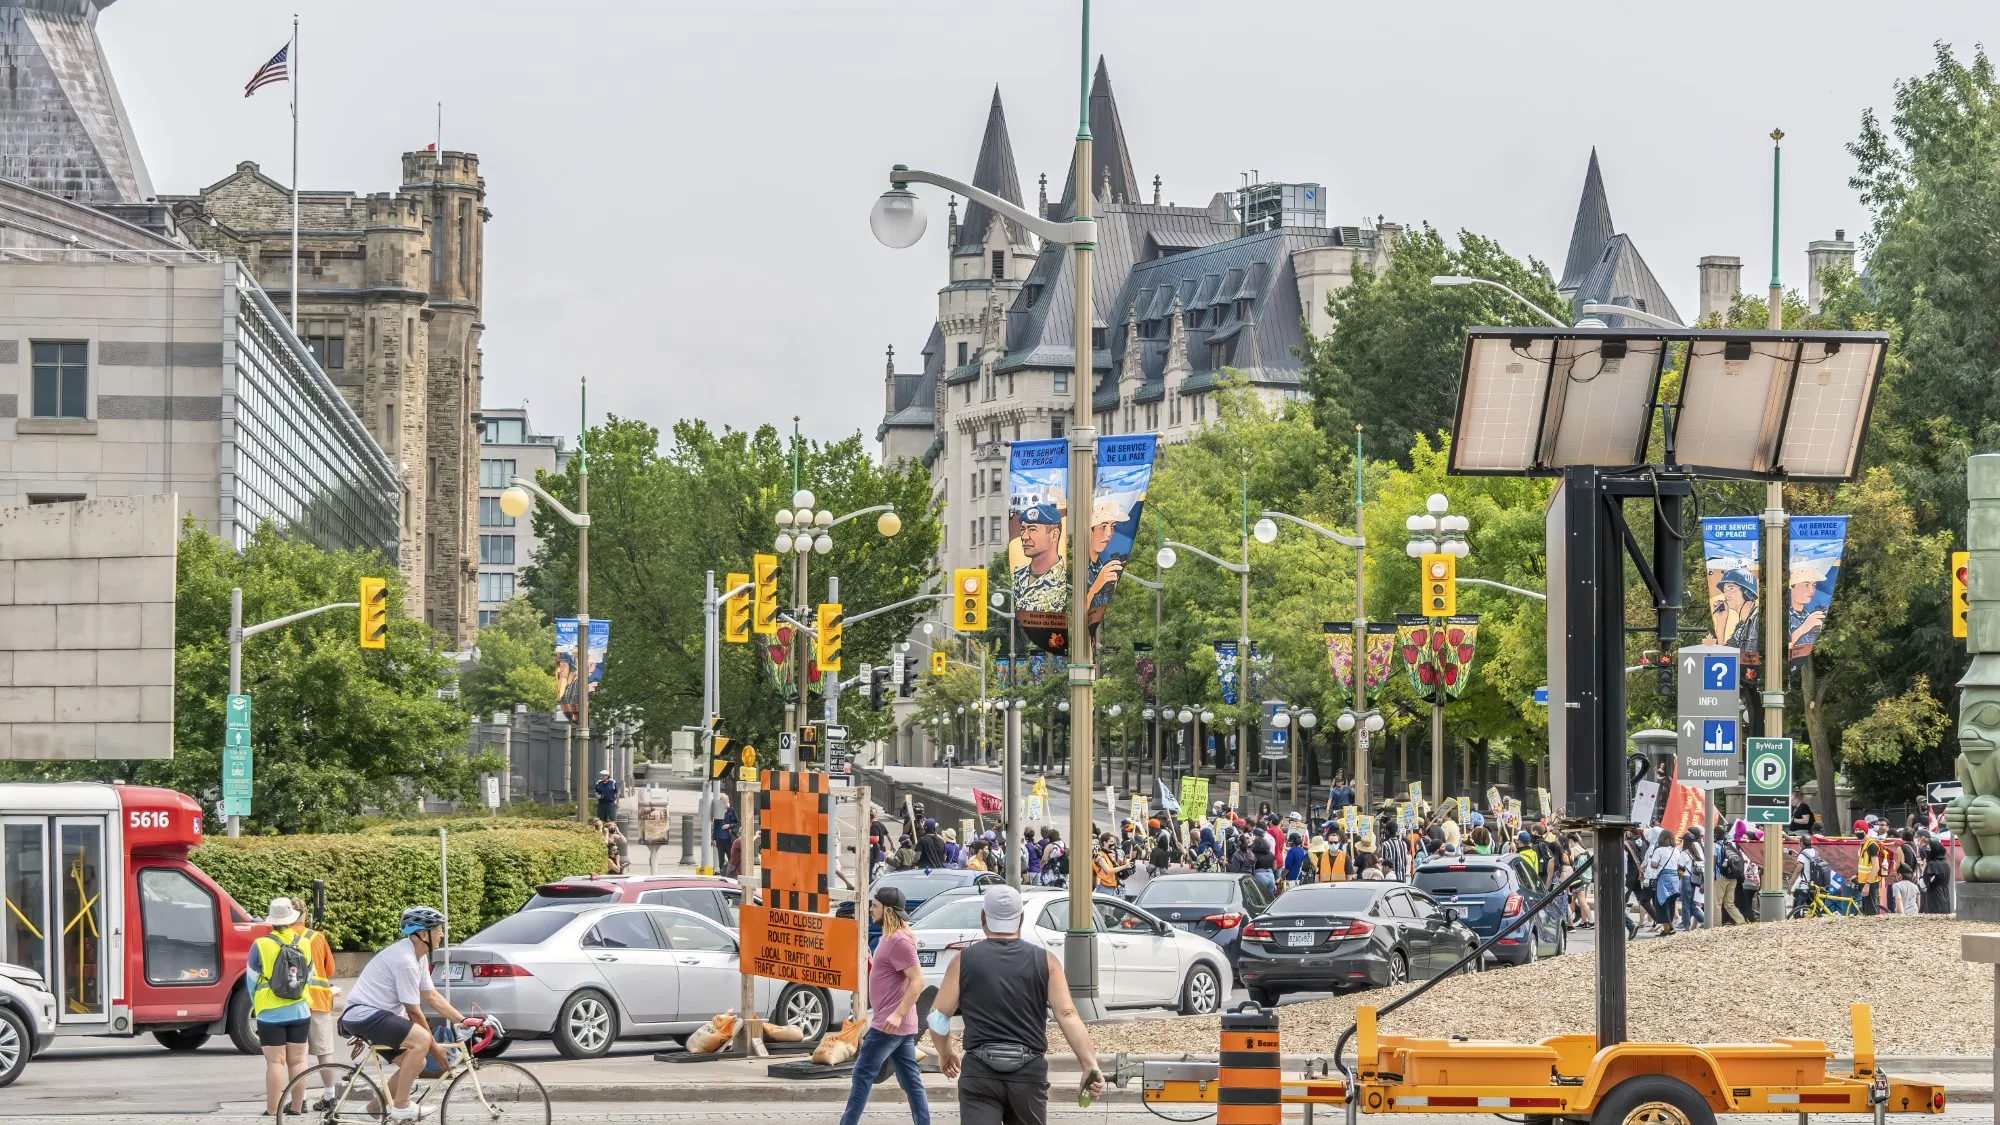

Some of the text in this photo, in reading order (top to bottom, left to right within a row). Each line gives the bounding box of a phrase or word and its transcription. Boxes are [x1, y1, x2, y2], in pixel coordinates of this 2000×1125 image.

[1022, 449, 1035, 457] THE
[1036, 446, 1065, 456] SERVICE
[1106, 443, 1147, 453] AU SERVICE
[1032, 457, 1054, 465] PEACE
[1107, 453, 1145, 462] DE LA PAIX
[1728, 523, 1757, 531] SERVICE
[1699, 697, 1718, 706] INFO
[1755, 742, 1783, 751] ByWard
[1686, 757, 1729, 767] Parliament
[1687, 768, 1728, 778] Parlement
[1763, 762, 1777, 781] P
[130, 811, 170, 828] 5616
[769, 911, 823, 930] ROAD CLOSED
[767, 930, 824, 950] ROUTE FERMÉE
[761, 946, 832, 968] LOCAL TRAFFIC ONLY
[754, 960, 841, 986] TRAFIC LOCAL SEULEMENT
